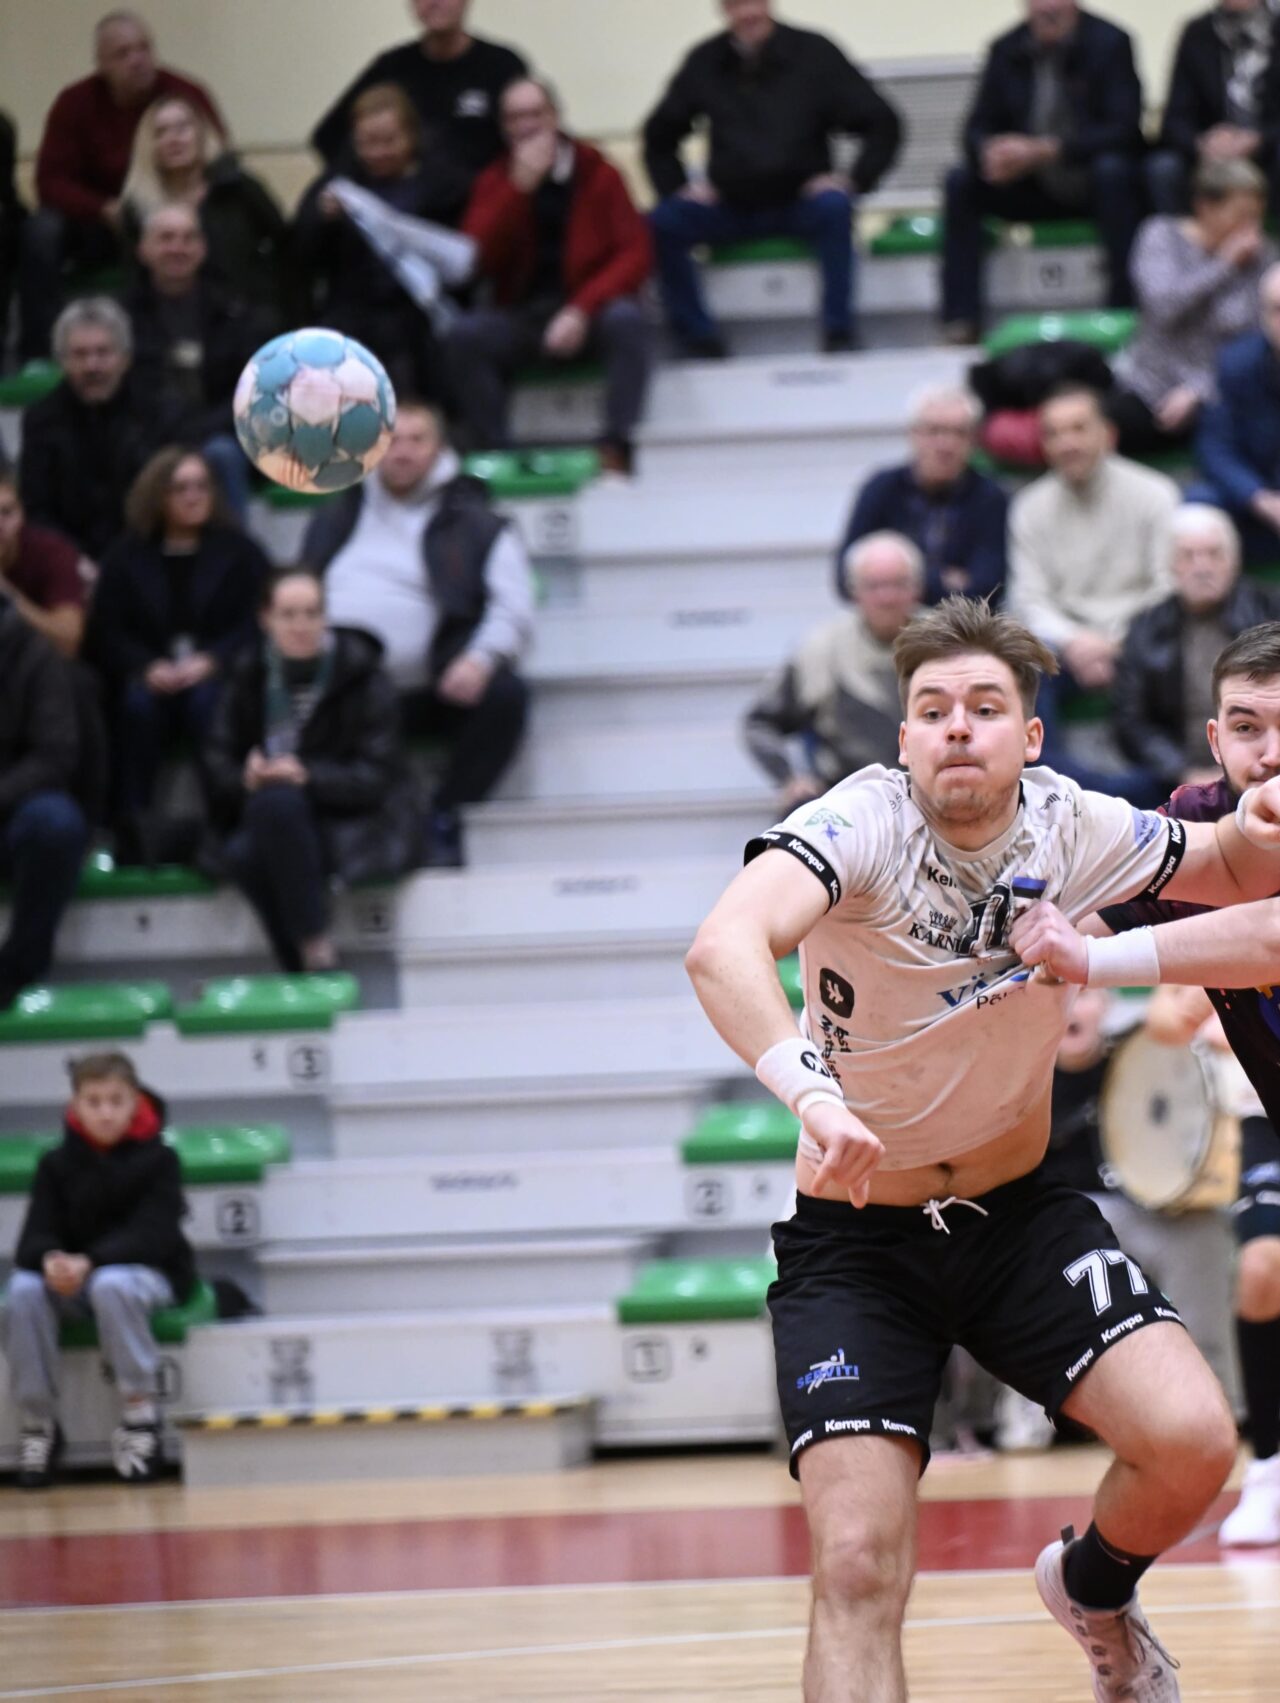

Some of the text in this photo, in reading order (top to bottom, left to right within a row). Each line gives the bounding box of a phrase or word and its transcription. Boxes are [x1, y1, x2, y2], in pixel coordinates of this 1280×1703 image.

[788, 838, 825, 873] Kempa
[1147, 855, 1177, 894] Kempa
[1063, 1249, 1149, 1317] 77
[1101, 1313, 1144, 1344] Kempa
[1065, 1348, 1094, 1382] Kempa
[825, 1419, 871, 1433] Kempa
[882, 1418, 917, 1435] Kempa
